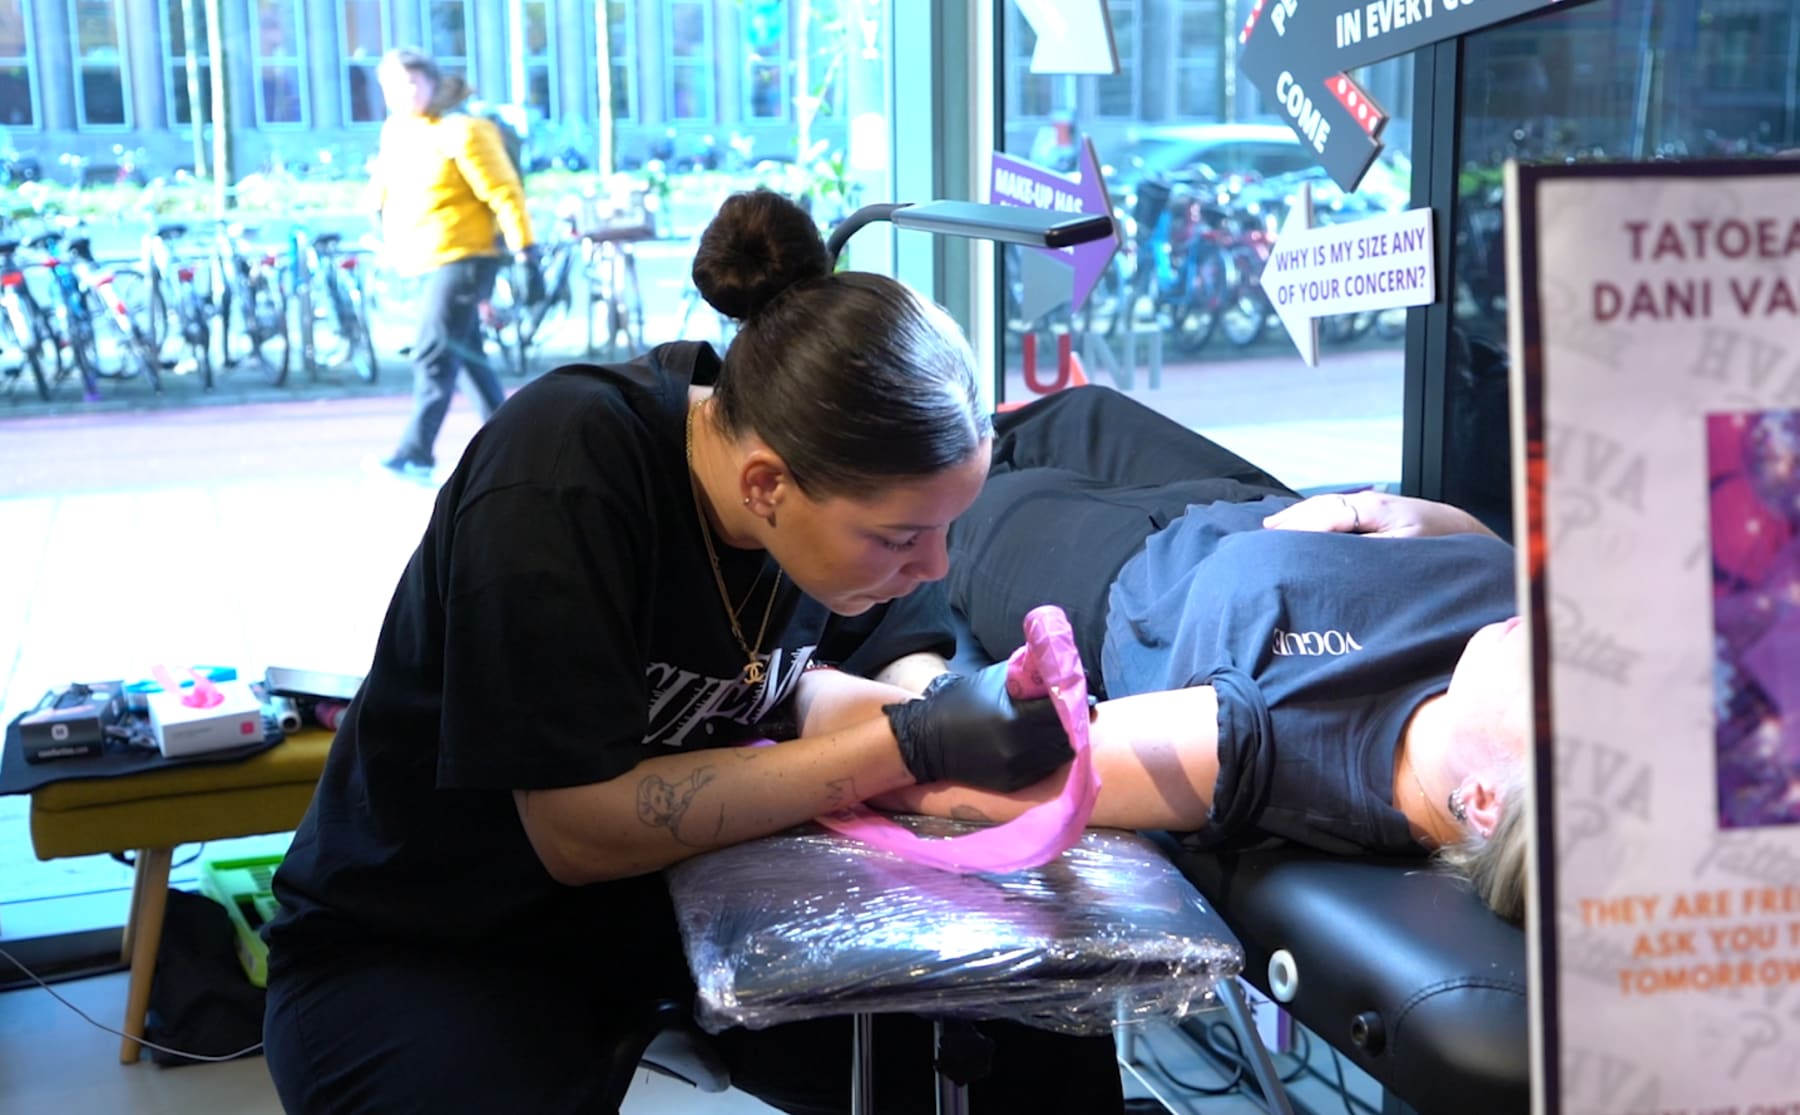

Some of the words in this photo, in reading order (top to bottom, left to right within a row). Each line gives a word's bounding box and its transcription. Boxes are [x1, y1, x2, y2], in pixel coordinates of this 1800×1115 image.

[1335, 9, 1361, 48] IN
[1366, 0, 1433, 38] EVERY
[1276, 71, 1331, 154] COME
[995, 167, 1054, 210] MAKE-UP
[1276, 248, 1308, 272] WHY
[1313, 244, 1326, 267] IS
[1331, 239, 1353, 264] MY
[1358, 233, 1388, 260] SIZE
[1392, 226, 1426, 254] ANY
[1278, 284, 1296, 306] OF
[1299, 278, 1341, 303] YOUR
[1345, 265, 1427, 297] CONCERN?
[1593, 278, 1711, 322] DANI
[1272, 627, 1363, 656] VOGUE
[1578, 894, 1660, 928] THEY
[1671, 888, 1731, 920] ARE
[1633, 929, 1696, 962] ASK
[1708, 923, 1777, 954] YOU
